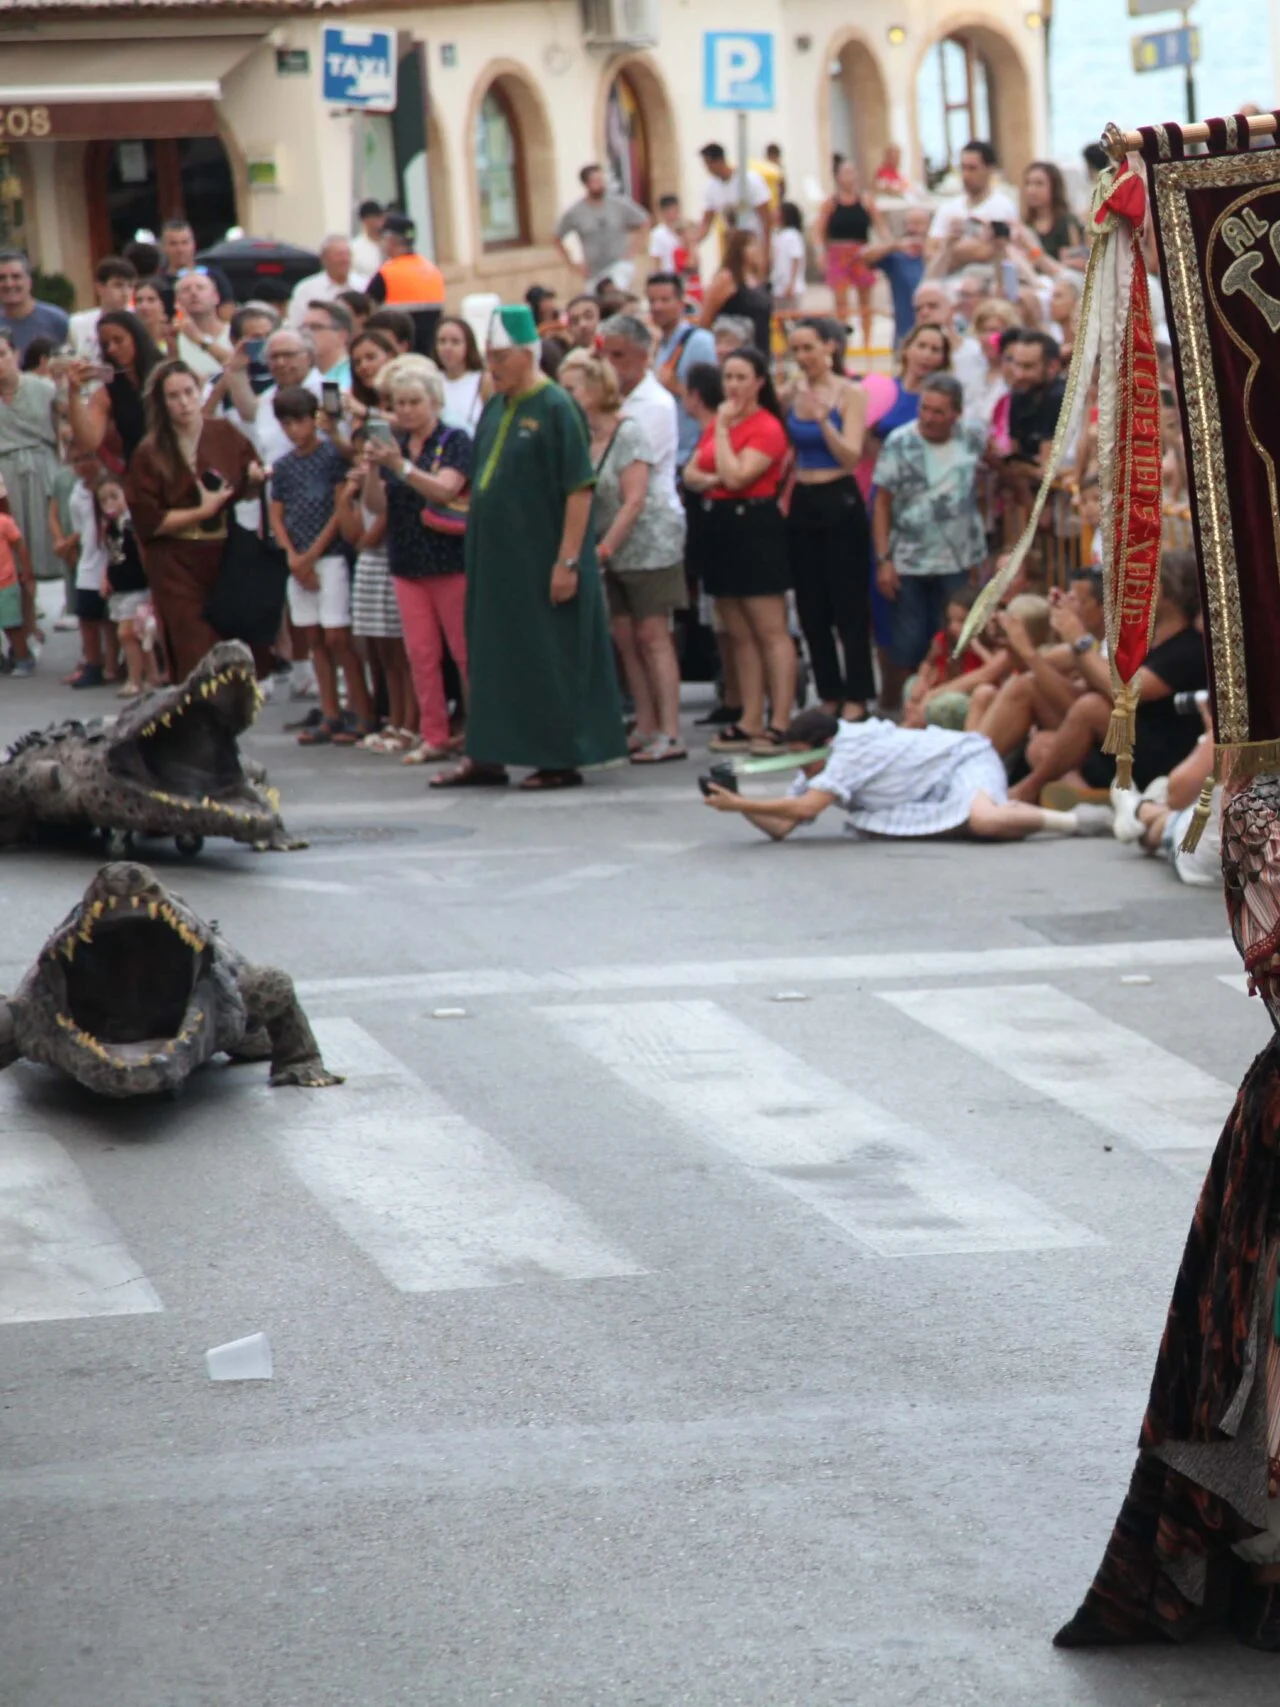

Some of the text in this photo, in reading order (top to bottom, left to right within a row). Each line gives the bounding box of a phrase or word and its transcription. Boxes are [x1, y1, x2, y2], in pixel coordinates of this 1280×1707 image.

[327, 52, 388, 79] TAXI
[714, 38, 762, 102] P
[0, 106, 52, 137] OS
[1221, 207, 1269, 256] AL
